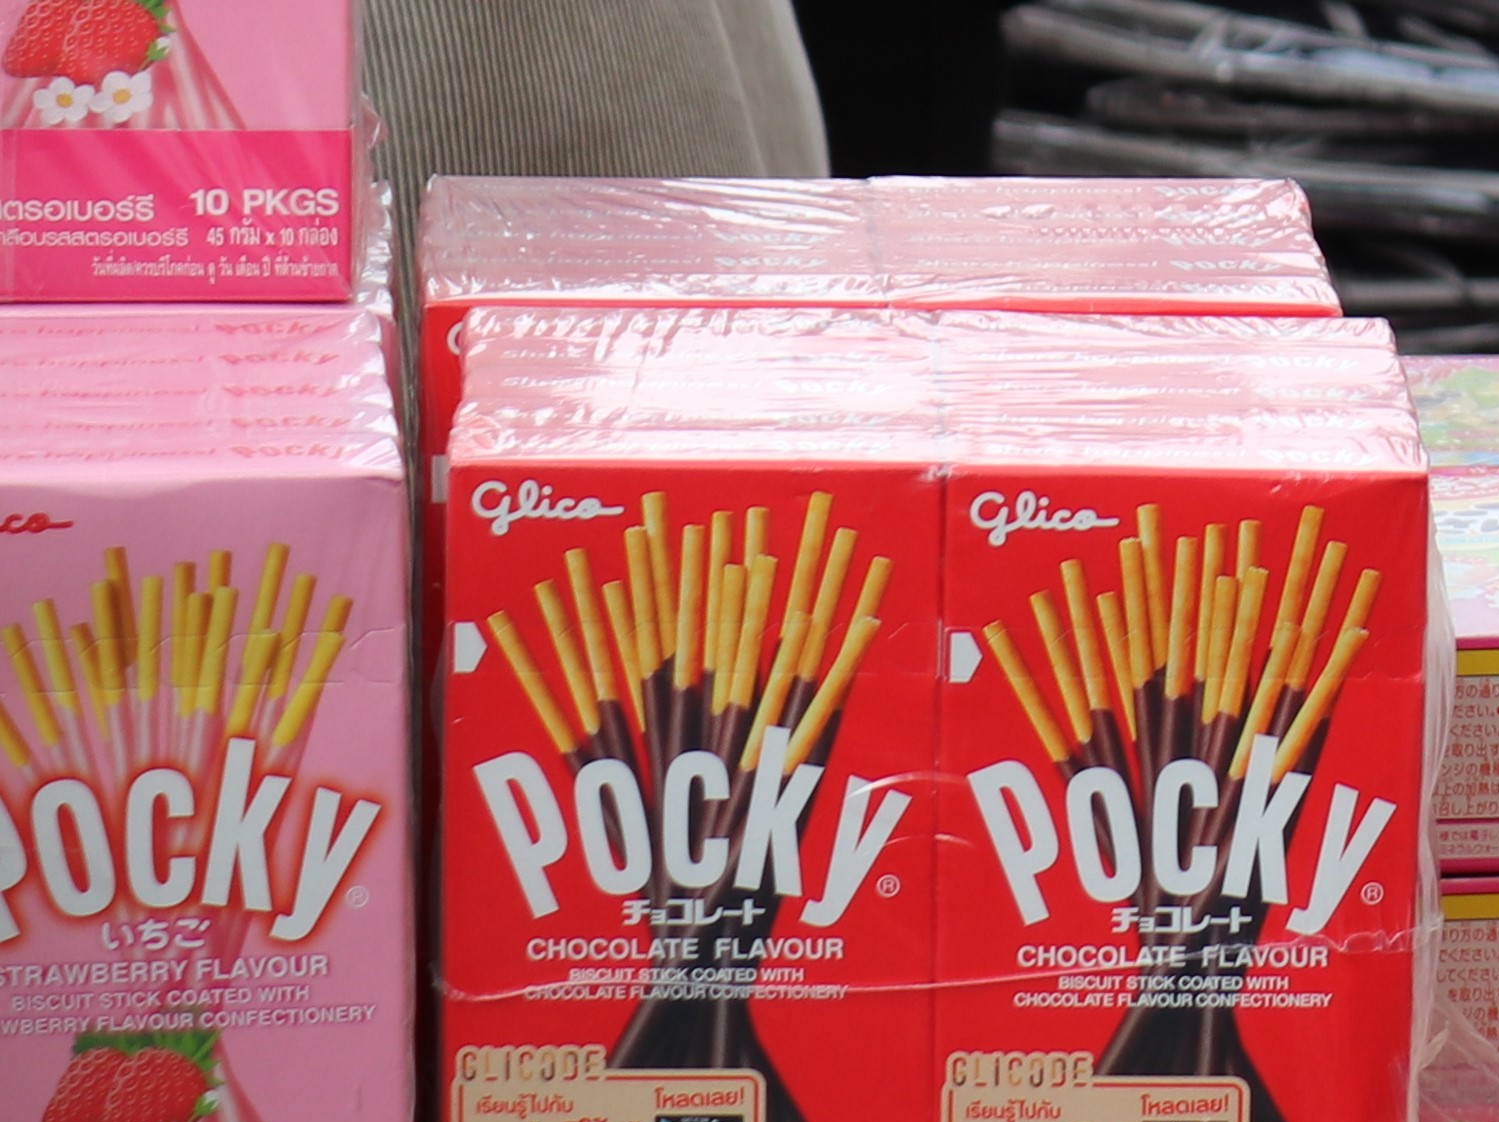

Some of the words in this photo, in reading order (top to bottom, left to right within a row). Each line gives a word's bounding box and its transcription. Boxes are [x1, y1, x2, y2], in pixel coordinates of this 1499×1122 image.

[0, 194, 154, 221] ตรอเบอร์รี
[189, 189, 229, 216] 10
[243, 189, 339, 216] PKGS
[470, 481, 625, 536] Glico
[969, 490, 1119, 547] Glico
[621, 898, 766, 926] チョコレート
[1111, 906, 1252, 934] チョコレート
[101, 917, 211, 950] いちご
[526, 937, 699, 960] CHOCOLATE
[714, 937, 844, 960] FLAVOUR
[1017, 945, 1186, 968] CHOCOLATE
[1202, 945, 1328, 968] FLAVOUR
[196, 956, 328, 979] FLAVOUR
[1058, 975, 1123, 990] BISCUIT
[1126, 975, 1176, 990] STICK
[1178, 975, 1244, 990] COATED
[1247, 975, 1289, 990] WITH
[13, 993, 93, 1011] BISCUIT
[99, 990, 161, 1008] STICK
[167, 988, 252, 1006] COATED
[259, 985, 309, 1001] WITH
[1013, 992, 1114, 1008] CHOCOLATE
[1117, 992, 1193, 1008] FLAVOUR
[1196, 992, 1332, 1008] CONFECTIONERY
[96, 1012, 193, 1031] FLAVOUR
[198, 1005, 376, 1027] CONFECTIONERY
